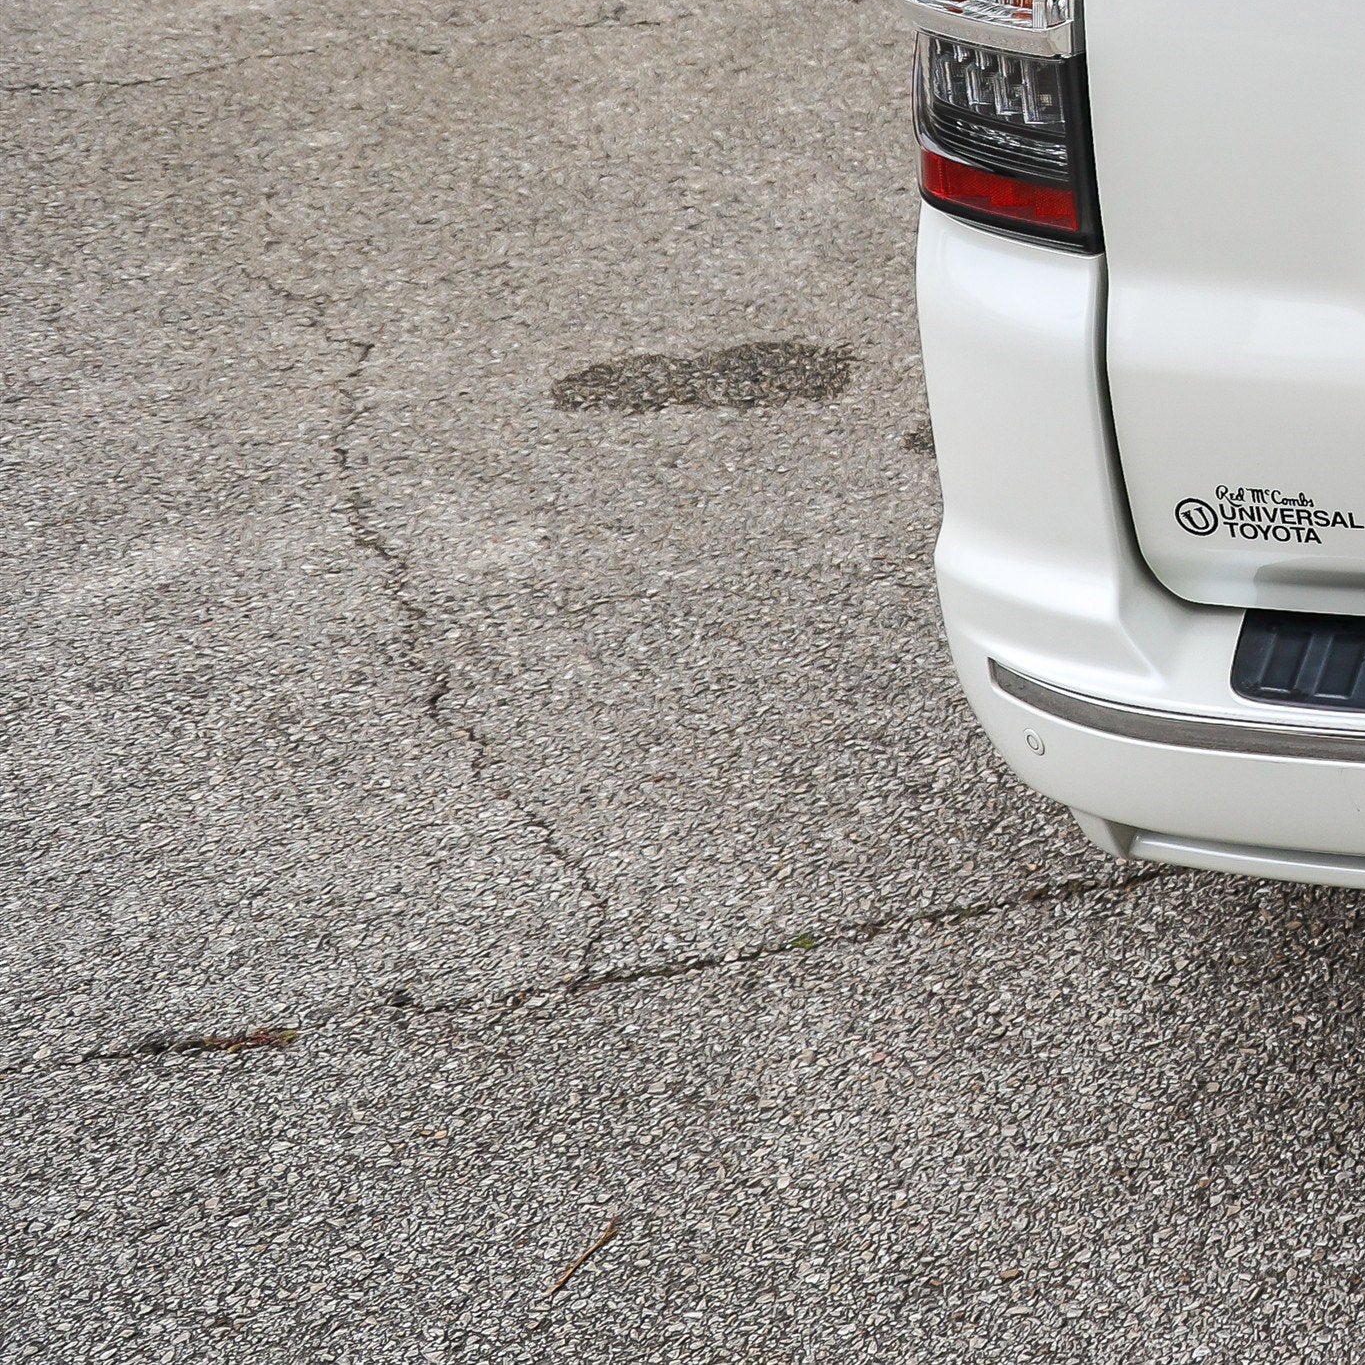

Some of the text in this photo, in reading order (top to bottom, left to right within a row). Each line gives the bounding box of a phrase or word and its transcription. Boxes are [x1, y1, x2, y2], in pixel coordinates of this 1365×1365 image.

[1215, 485, 1314, 507] Red McCombs
[1219, 503, 1365, 529] UNIVERSAL
[1223, 521, 1322, 544] TOYOTA
